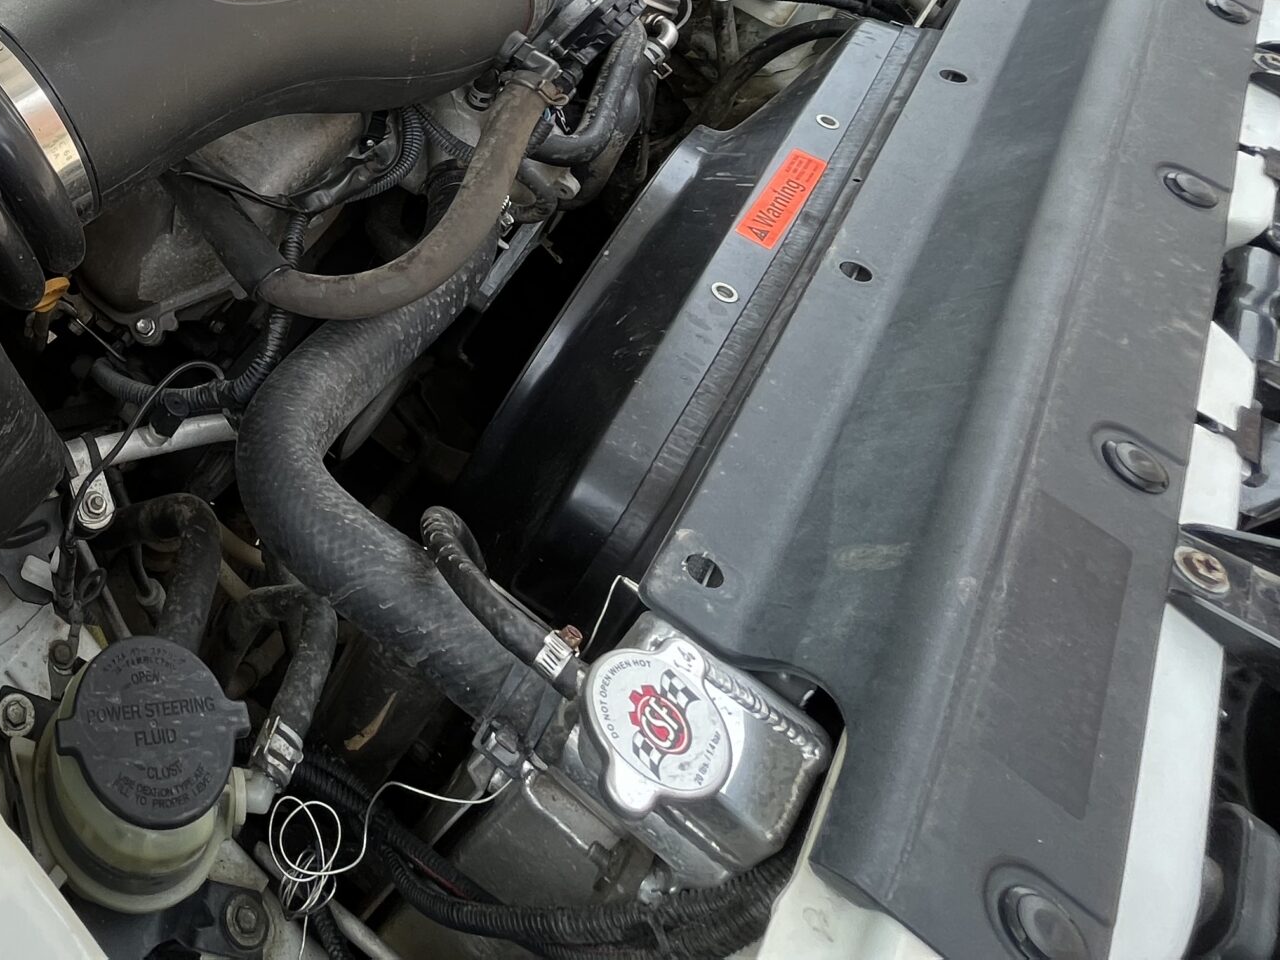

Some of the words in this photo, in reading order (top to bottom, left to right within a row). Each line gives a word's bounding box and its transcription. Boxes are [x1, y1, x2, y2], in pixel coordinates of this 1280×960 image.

[753, 178, 806, 228] Warning
[608, 659, 632, 676] WHEN
[632, 658, 652, 668] HOT
[131, 670, 160, 685] OPEN
[599, 674, 613, 699] OPEN
[87, 704, 142, 724] POWER
[144, 696, 216, 719] STEERING
[599, 701, 611, 721] NOT
[606, 723, 620, 739] DO
[641, 697, 679, 748] CSF
[134, 728, 177, 747] FLUID
[135, 794, 148, 806] TO
